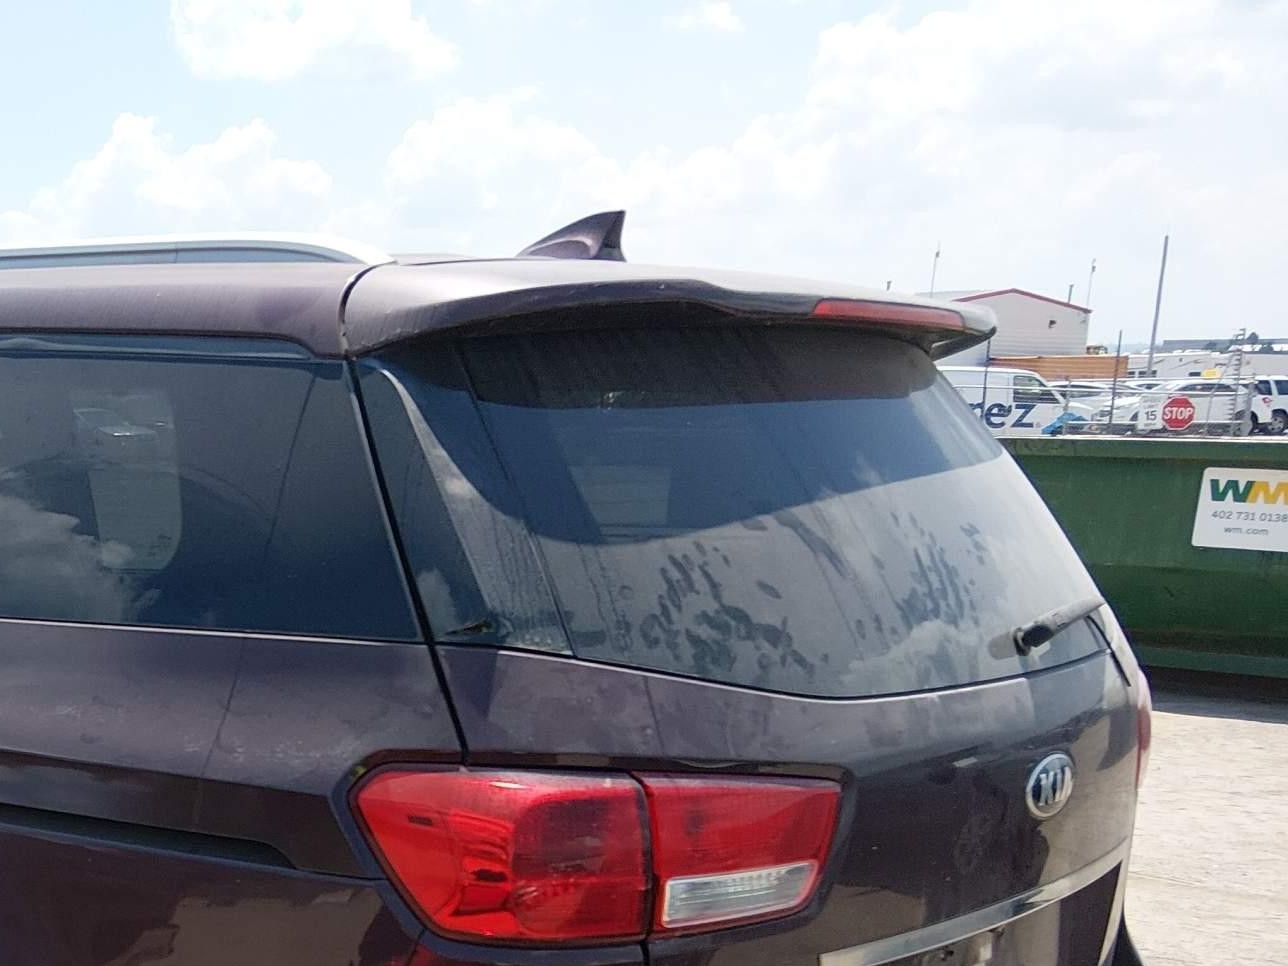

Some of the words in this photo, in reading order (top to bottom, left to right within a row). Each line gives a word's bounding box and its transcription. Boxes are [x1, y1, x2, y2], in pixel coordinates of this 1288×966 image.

[1144, 409, 1158, 421] 15
[1163, 407, 1194, 420] STOP
[1210, 479, 1288, 506] WM
[1211, 510, 1233, 520] 402
[1236, 511, 1257, 521] 731
[1259, 512, 1288, 523] 0138
[1224, 527, 1269, 536] wm.com
